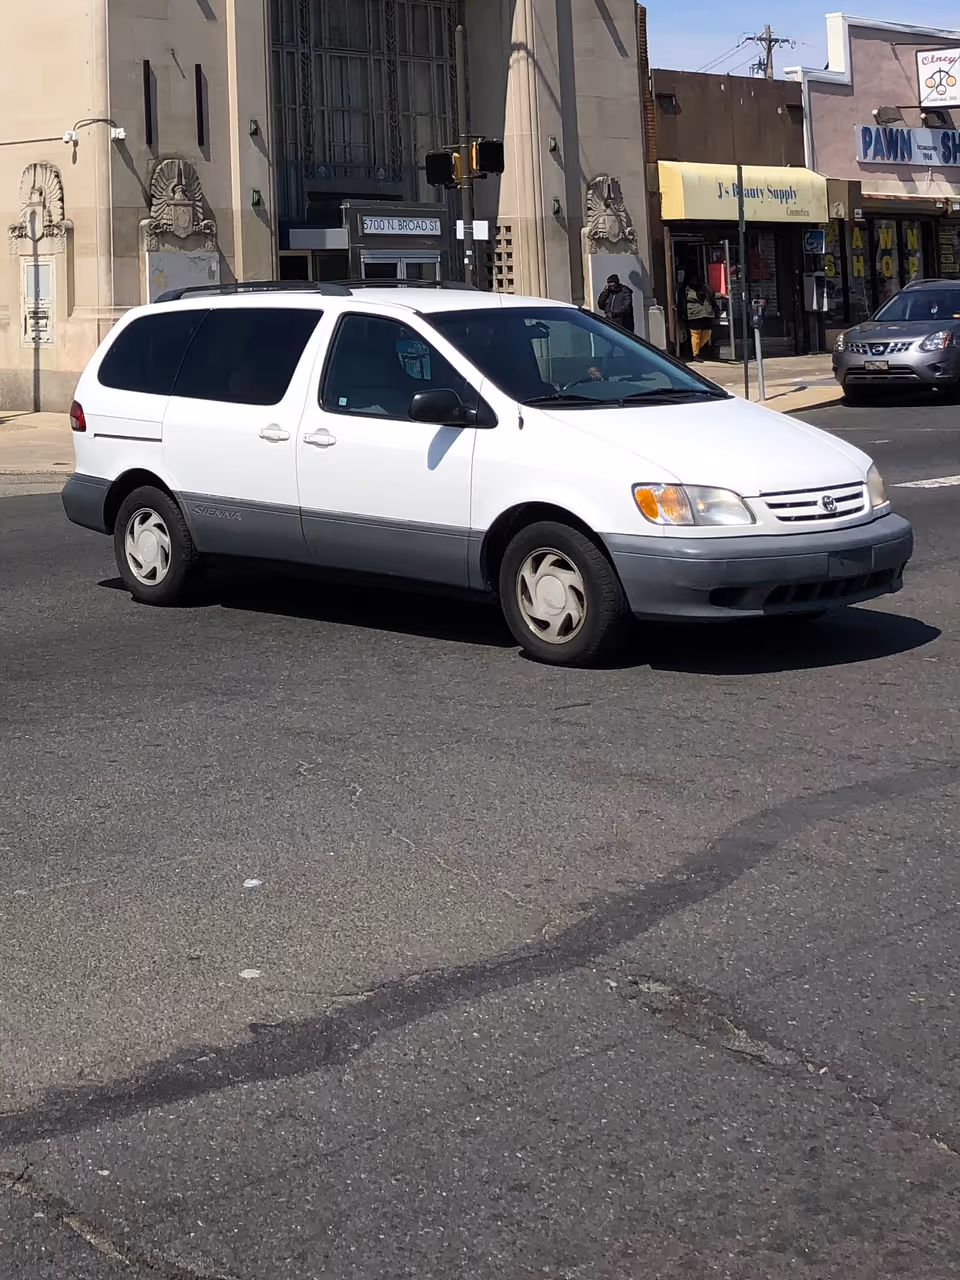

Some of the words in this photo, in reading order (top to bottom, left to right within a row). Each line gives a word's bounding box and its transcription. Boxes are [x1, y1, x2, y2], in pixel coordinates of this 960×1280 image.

[861, 126, 913, 162] PAWN
[717, 181, 730, 199] J's
[732, 182, 764, 204] Bauty
[766, 184, 798, 205] Supply
[398, 220, 428, 231] BROAD
[193, 505, 243, 521] SIENNA
